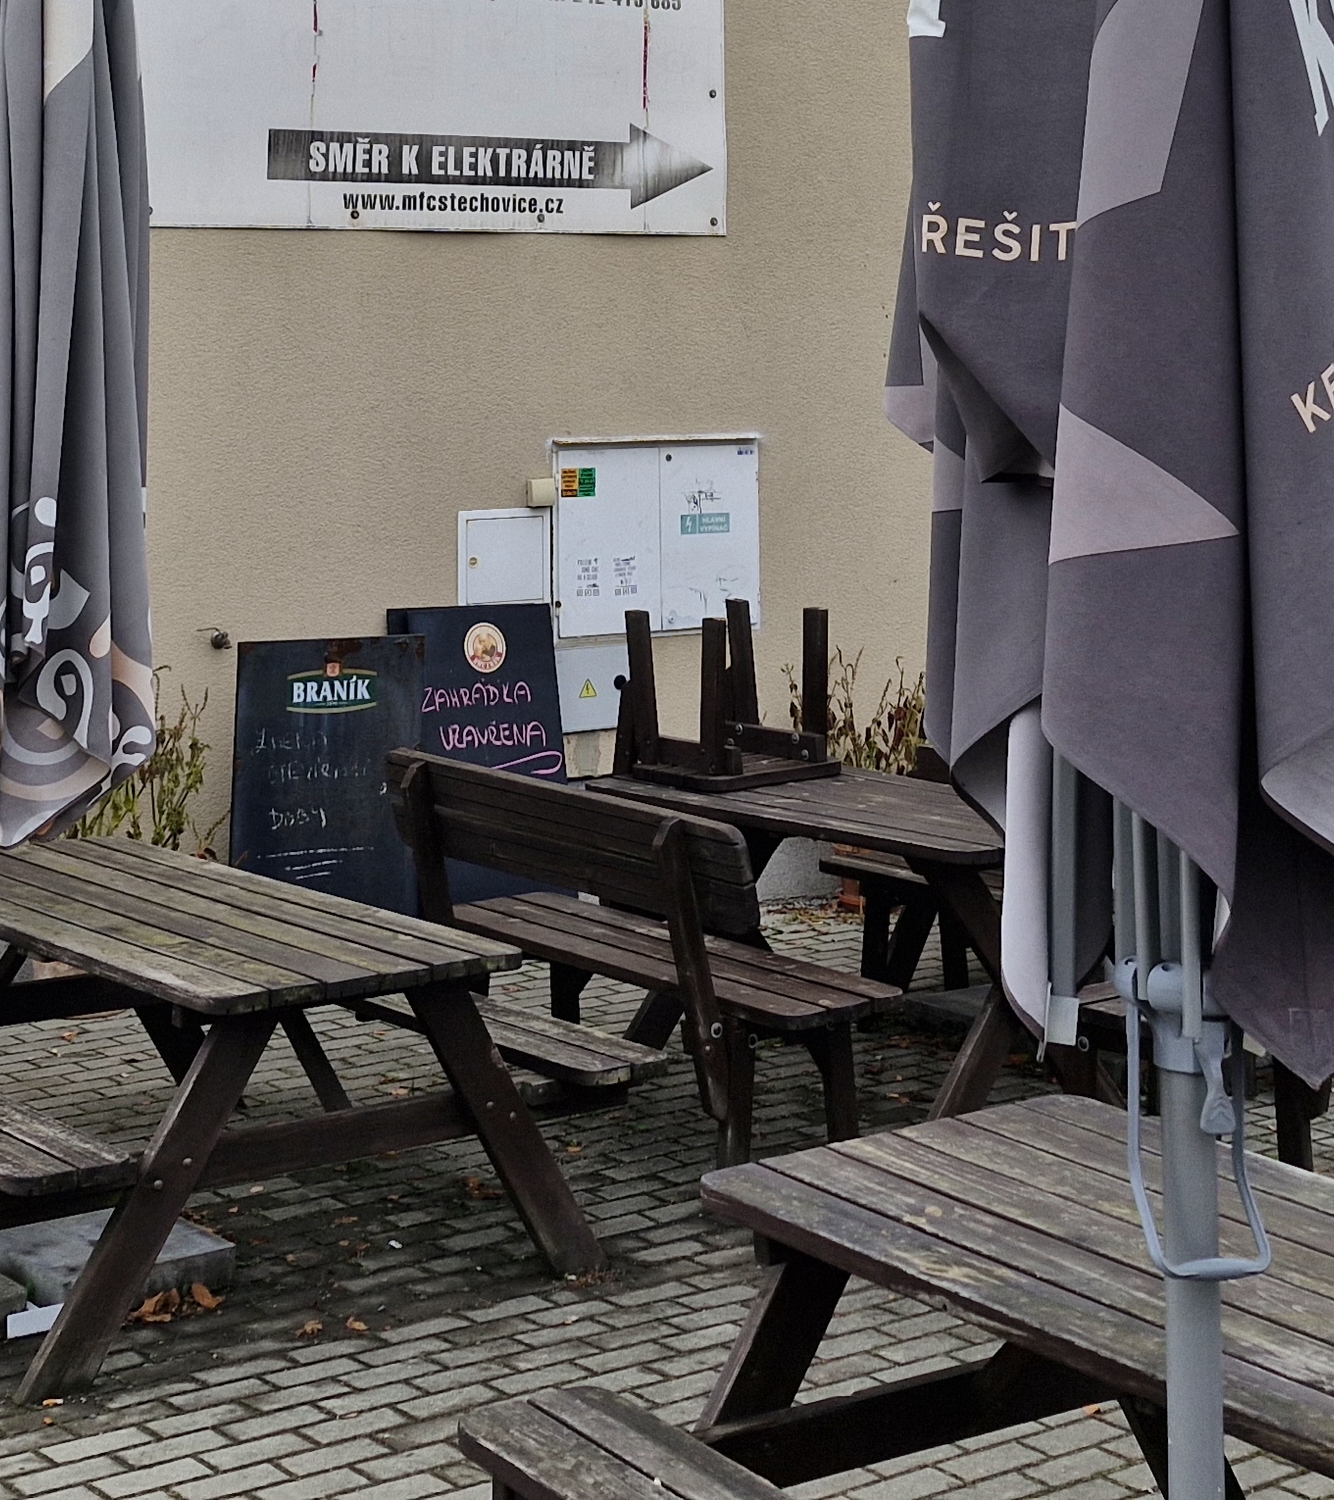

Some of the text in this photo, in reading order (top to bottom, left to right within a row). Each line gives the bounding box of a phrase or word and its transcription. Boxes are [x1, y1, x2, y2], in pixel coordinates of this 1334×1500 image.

[308, 136, 595, 180] SMĚR K ELEKTRÁRNĚ
[342, 191, 565, 214] www.mfcstechovice.cz
[920, 200, 1078, 263] ŘEŠIT
[291, 674, 372, 704] BRANÍK
